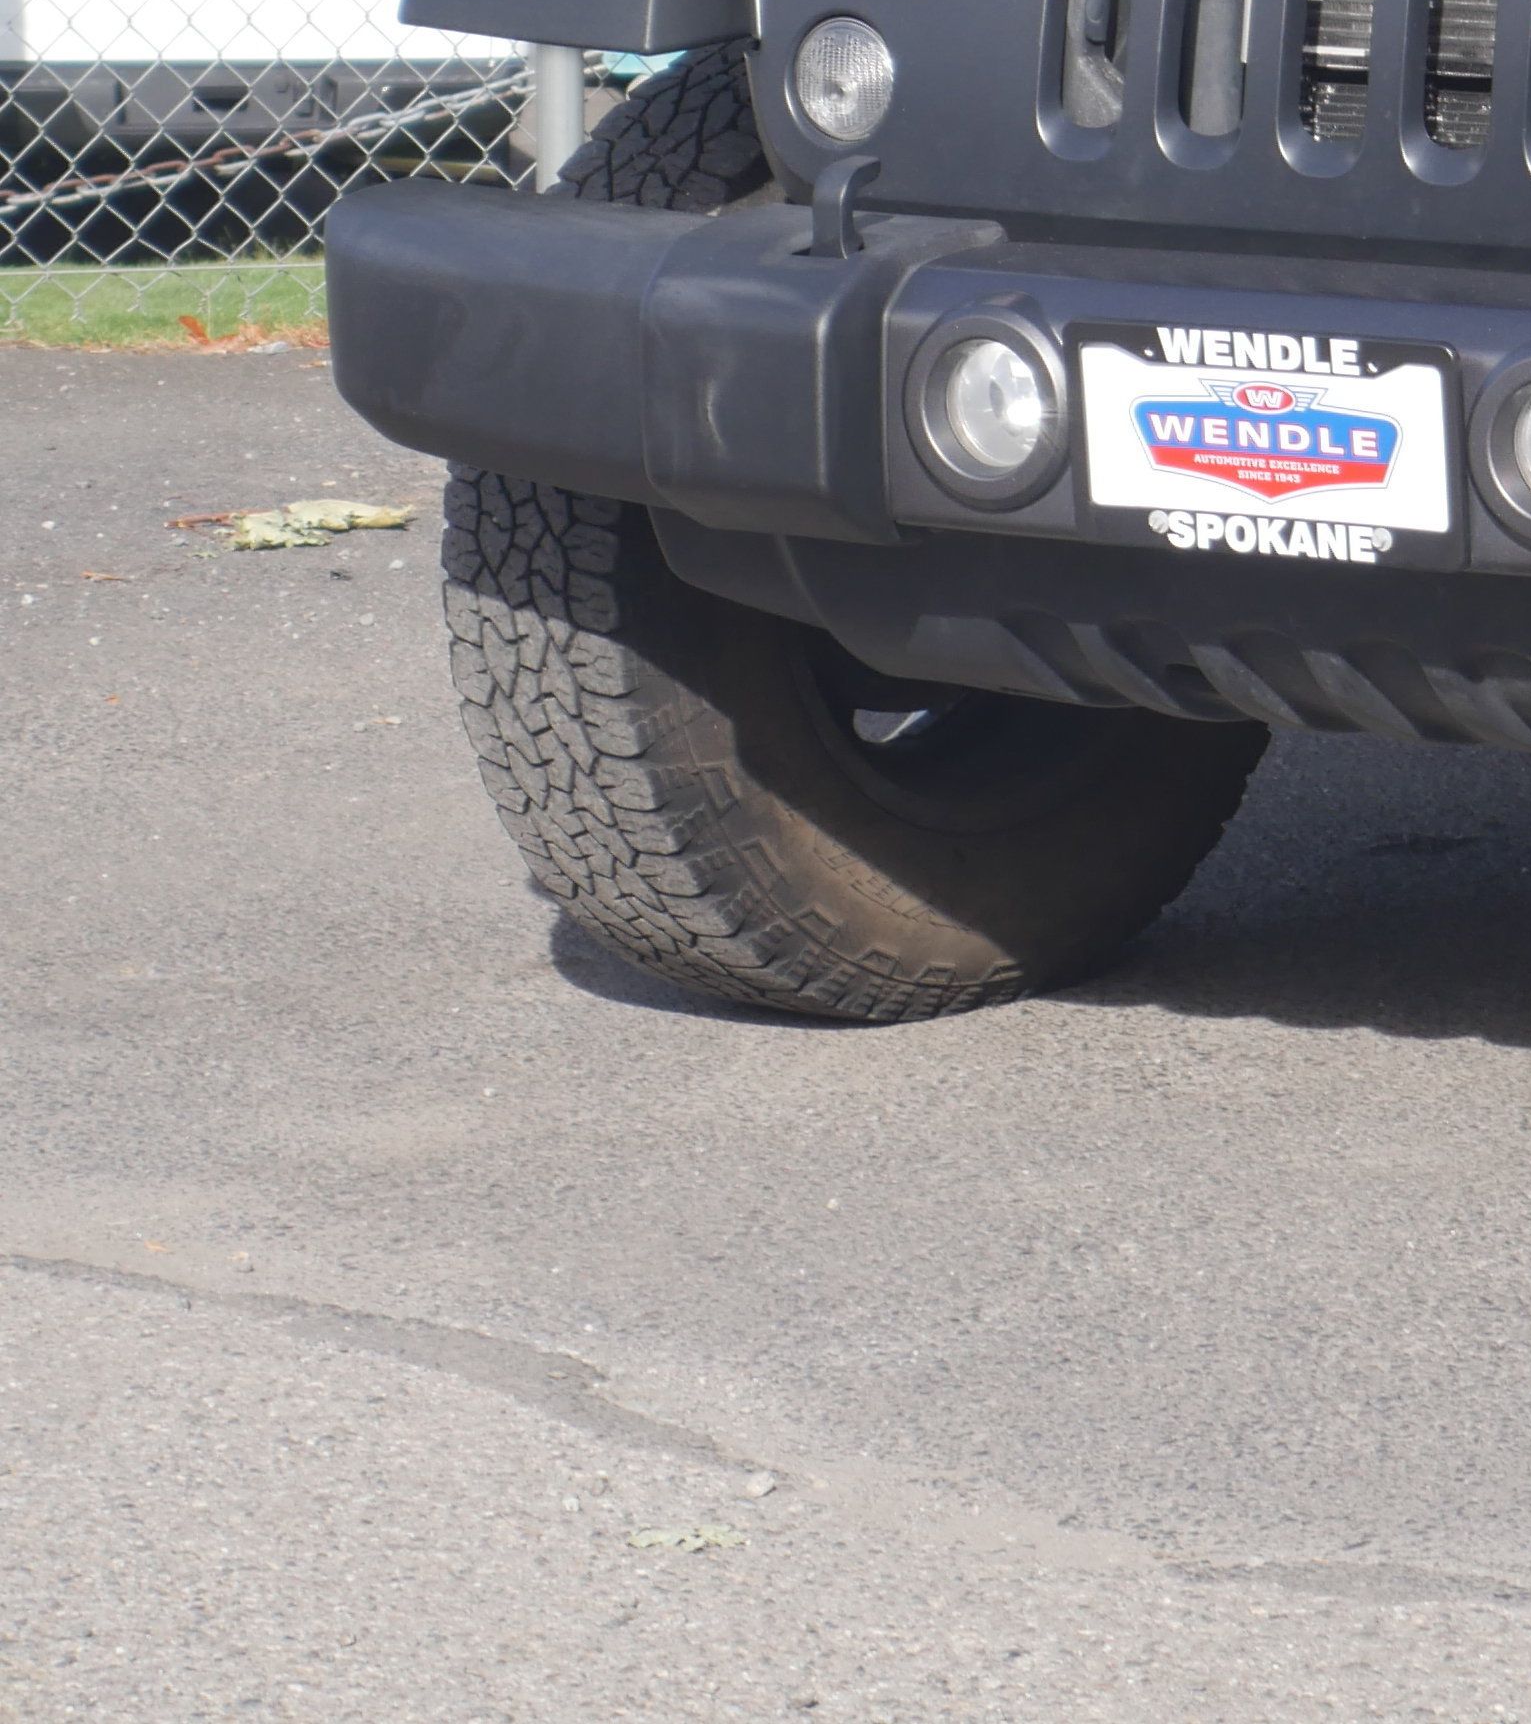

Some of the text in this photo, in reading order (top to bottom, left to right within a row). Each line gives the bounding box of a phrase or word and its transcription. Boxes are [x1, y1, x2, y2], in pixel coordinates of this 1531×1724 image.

[1156, 326, 1361, 376] WENDLE
[1148, 412, 1379, 459] WENDLE
[1193, 454, 1340, 475] AUTOMOTIVE EXCELLENCE
[1237, 469, 1272, 482] SINCE
[1167, 510, 1377, 564] SPOKANE
